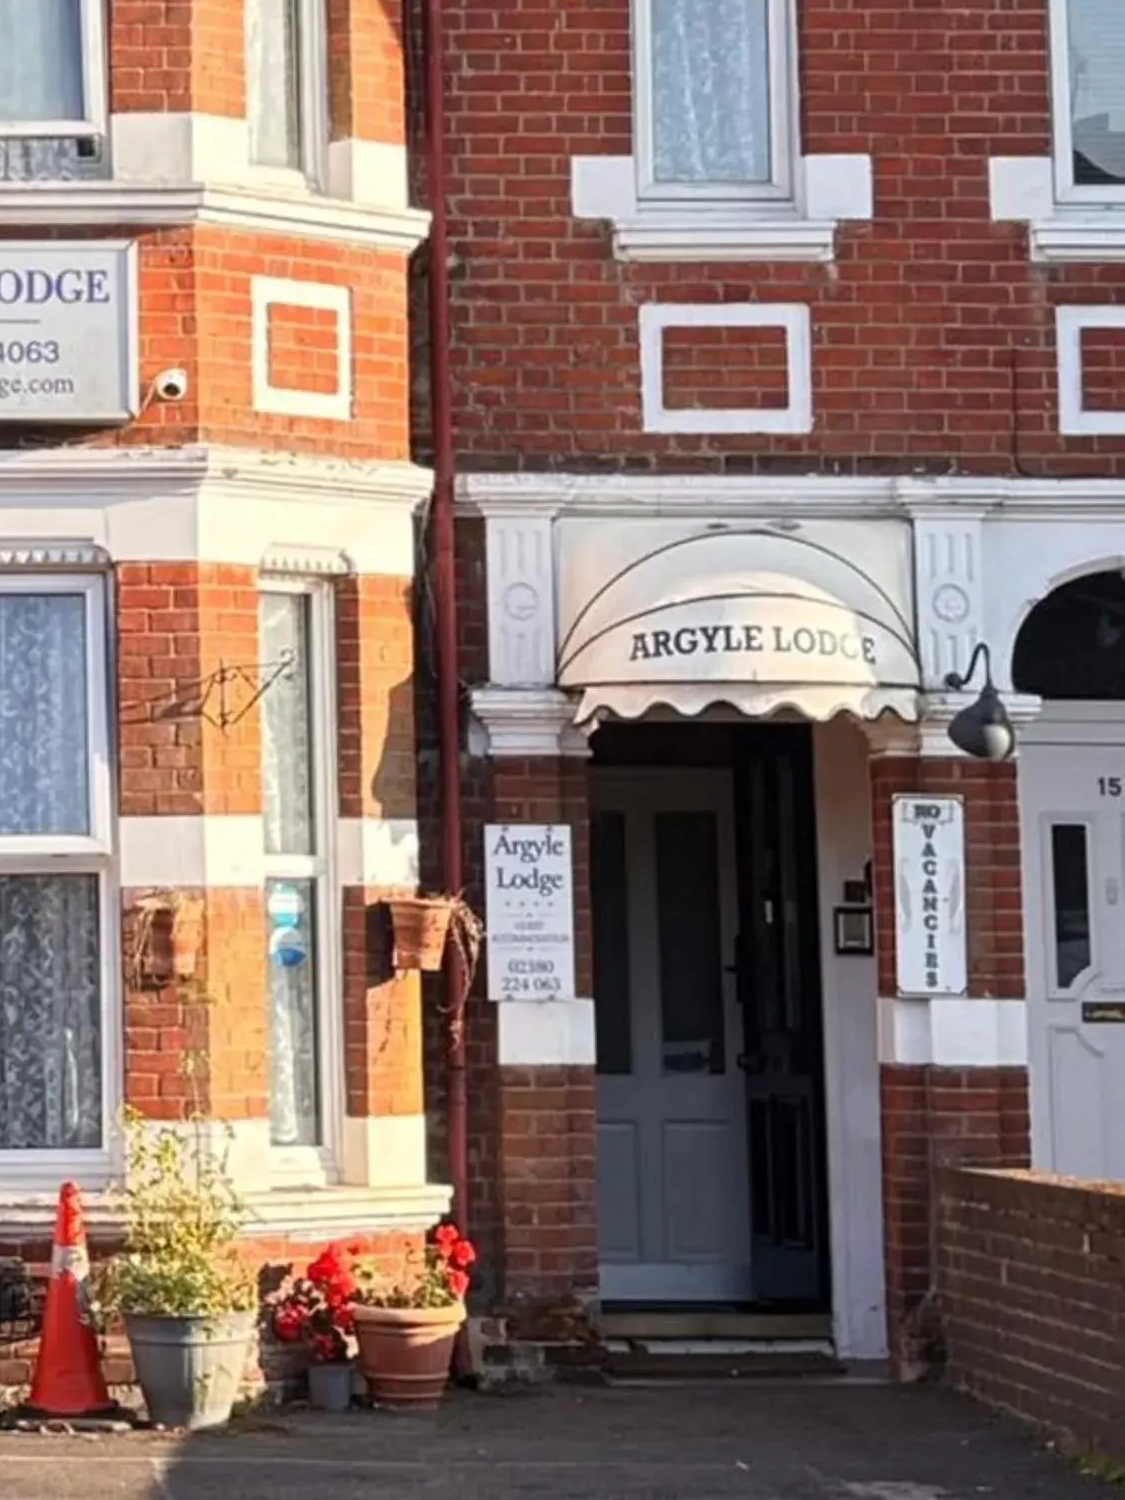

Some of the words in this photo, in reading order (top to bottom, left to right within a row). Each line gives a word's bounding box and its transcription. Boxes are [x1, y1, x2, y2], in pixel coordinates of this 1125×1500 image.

[629, 625, 763, 661] ARGYLE
[772, 626, 876, 664] LODGE
[1097, 776, 1122, 797] 15
[492, 833, 565, 863] Argyle
[496, 867, 564, 896] Lodge
[920, 823, 939, 988] VACANCIES
